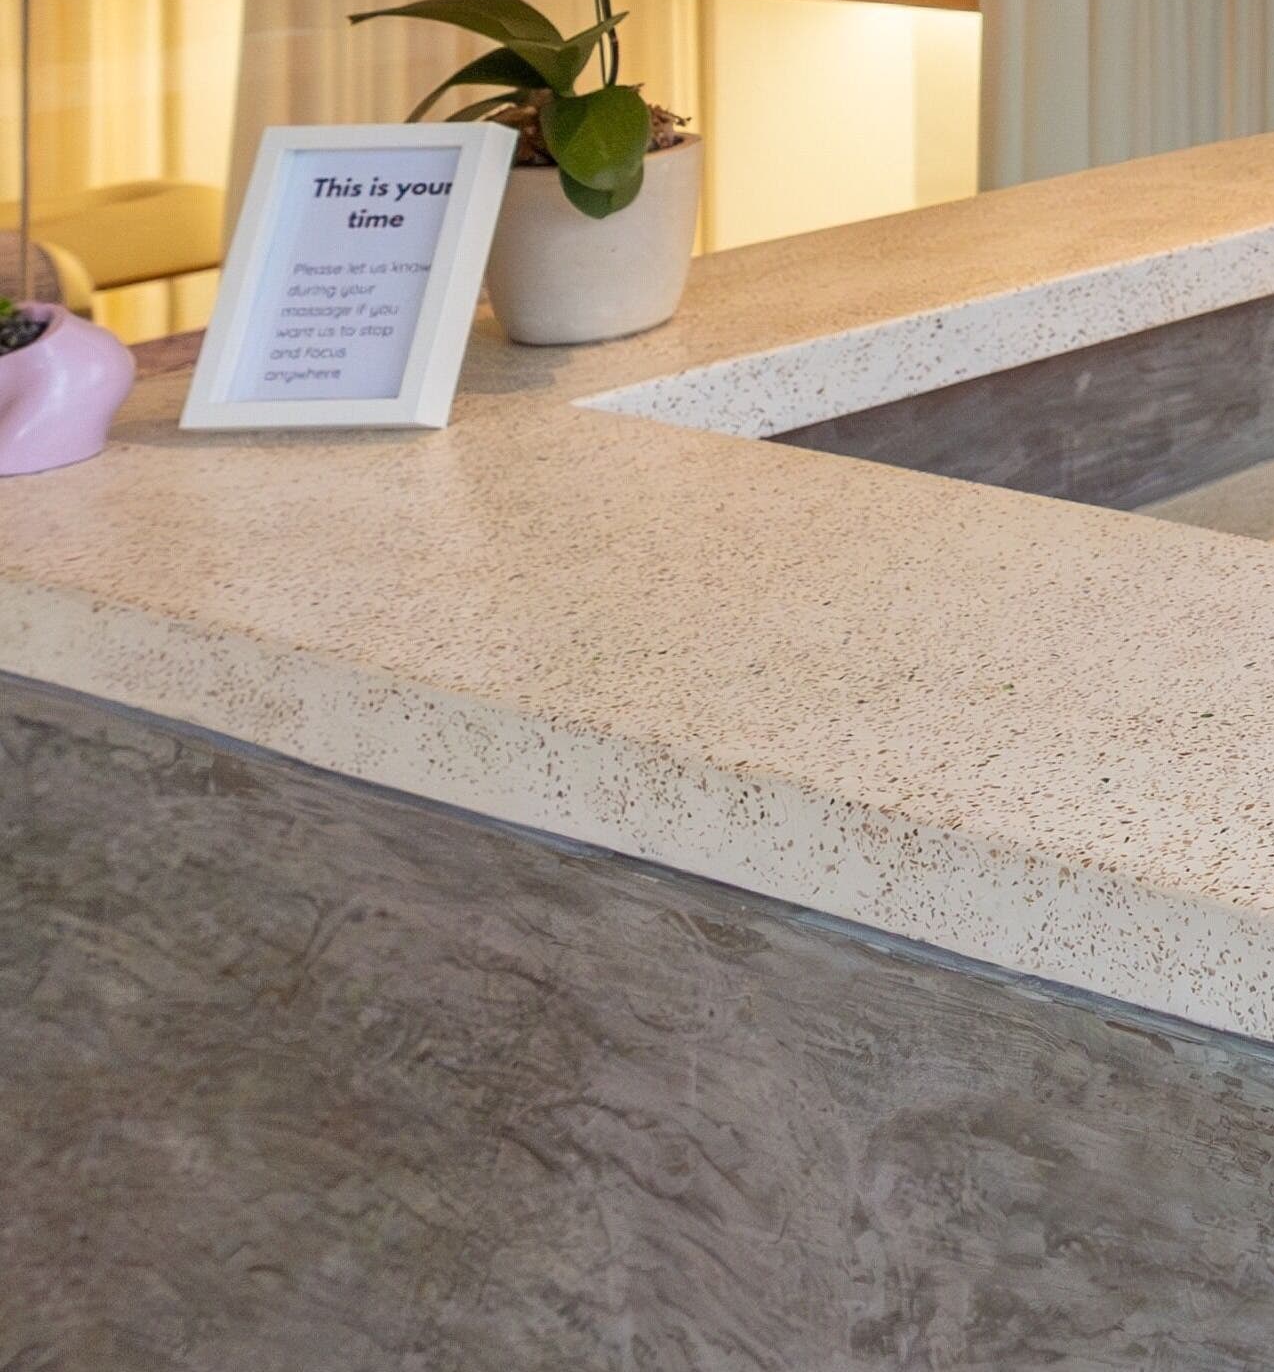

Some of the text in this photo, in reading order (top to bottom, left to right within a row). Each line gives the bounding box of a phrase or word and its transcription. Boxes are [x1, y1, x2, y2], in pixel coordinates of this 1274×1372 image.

[313, 177, 453, 202] This is your
[348, 209, 404, 229] time
[293, 263, 342, 275] Please
[348, 263, 366, 275] let
[369, 264, 387, 274] us
[287, 284, 376, 299] during your
[281, 303, 399, 319] massage if you
[276, 325, 394, 339] want us to stop
[270, 347, 346, 359] and focus
[263, 368, 341, 383] anywhere
